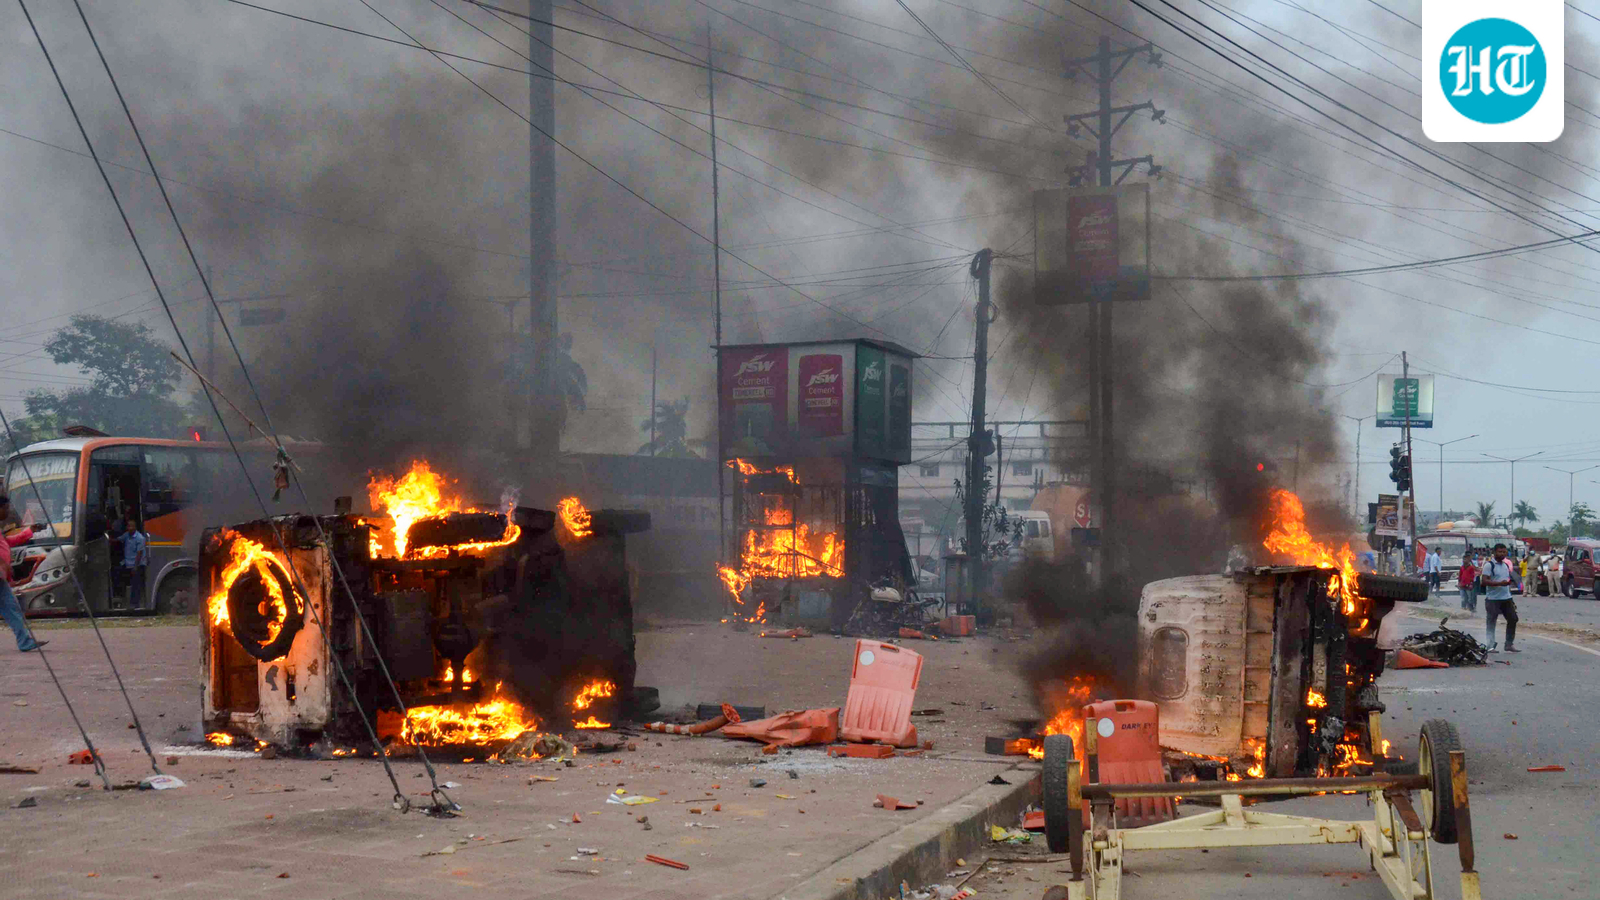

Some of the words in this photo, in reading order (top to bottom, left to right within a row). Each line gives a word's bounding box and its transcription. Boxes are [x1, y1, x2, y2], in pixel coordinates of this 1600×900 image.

[733, 359, 775, 376] JSW
[737, 377, 770, 386] Cement
[805, 372, 839, 387] JSW
[808, 387, 835, 395] Cement
